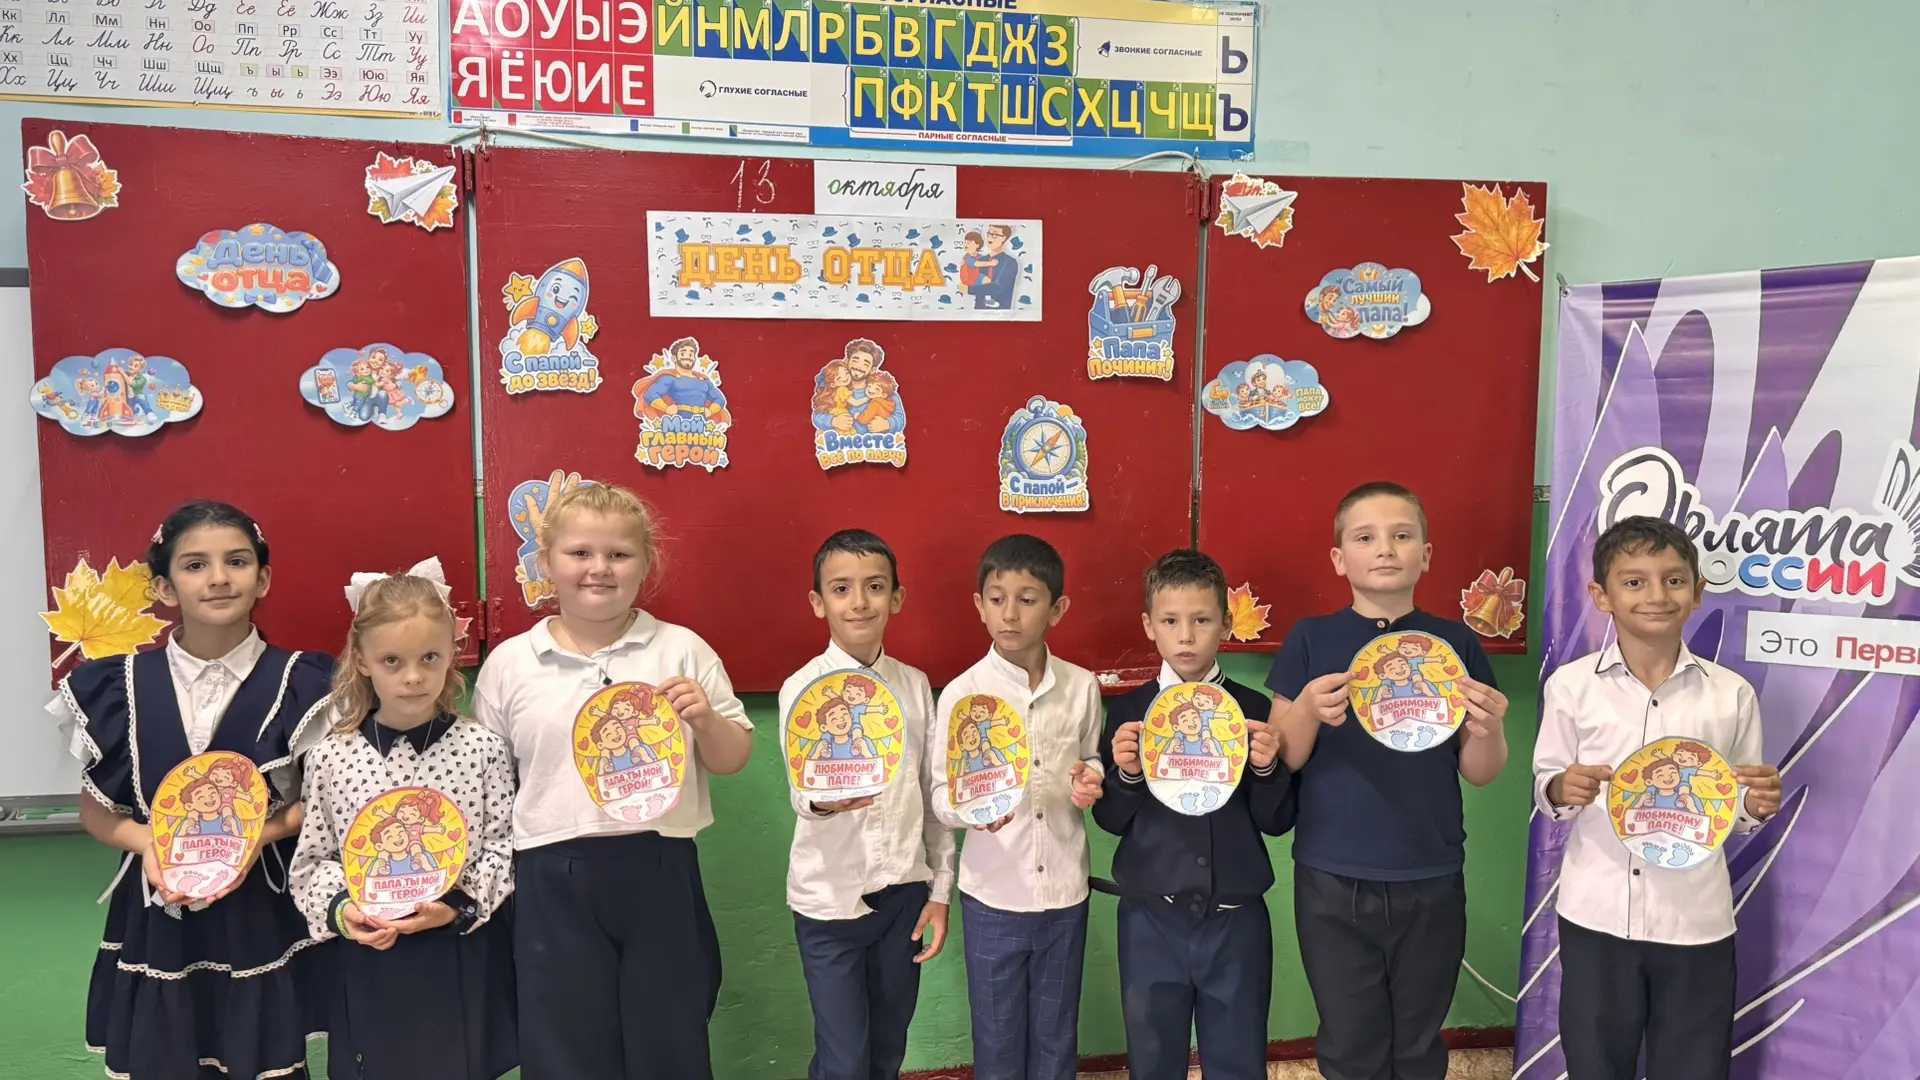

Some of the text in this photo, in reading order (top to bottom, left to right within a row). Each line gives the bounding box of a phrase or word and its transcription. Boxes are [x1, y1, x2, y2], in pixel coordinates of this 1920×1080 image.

[618, 1, 648, 44] Э
[697, 5, 728, 48] Н
[734, 7, 770, 51] М
[774, 9, 808, 52] Л
[819, 12, 846, 53] Р
[856, 14, 883, 56] Б
[894, 16, 921, 58] В
[934, 19, 957, 60] Г
[966, 21, 999, 68] Д
[1002, 23, 1037, 65] Ж
[1044, 25, 1068, 67] З
[1114, 45, 1203, 57] ЗВОНКИЕ СОГЛАСНЫЕ
[1221, 35, 1249, 74] Ь
[457, 50, 646, 106] Я Ё Ю И Е
[718, 86, 808, 98] ГЛУХИЕ СОГЛАСНЫЕ
[854, 77, 1214, 137] П Ф К Т Ш С Х Ц Ч Щ
[1218, 93, 1249, 131] Ъ
[918, 131, 1007, 142] ПАРНЫЕ СОГЛАСНЫЕ
[730, 159, 776, 211] 13
[828, 168, 944, 210] октября
[207, 239, 311, 270] День
[678, 243, 946, 293] ДЕНЬ ОТЦА
[1342, 276, 1404, 294] Самый
[1103, 337, 1160, 359] Папа
[504, 351, 524, 374] С
[525, 351, 581, 372] папой
[661, 415, 705, 433] Мой
[824, 431, 896, 452] Вместе
[1009, 476, 1021, 493] С
[1023, 478, 1065, 495] папой
[1605, 453, 1893, 567] Орлята
[1700, 553, 1886, 598] оссии
[1760, 629, 1920, 669] Это Перв
[1379, 699, 1440, 714] ЛЮБИМОМУ
[1393, 708, 1425, 719] ПАПЕ!
[815, 763, 876, 775] ЛЮБИМОМУ
[1169, 758, 1222, 769] ЛЮБИМОМУ
[626, 771, 642, 781] ТЫ
[828, 775, 861, 786] ПАПЕ!
[1635, 811, 1702, 828] ЛЮБИМОМУ
[1648, 820, 1684, 835] ПАПЕ!
[214, 838, 229, 847] ТЫ
[404, 877, 420, 886] ТЫ
